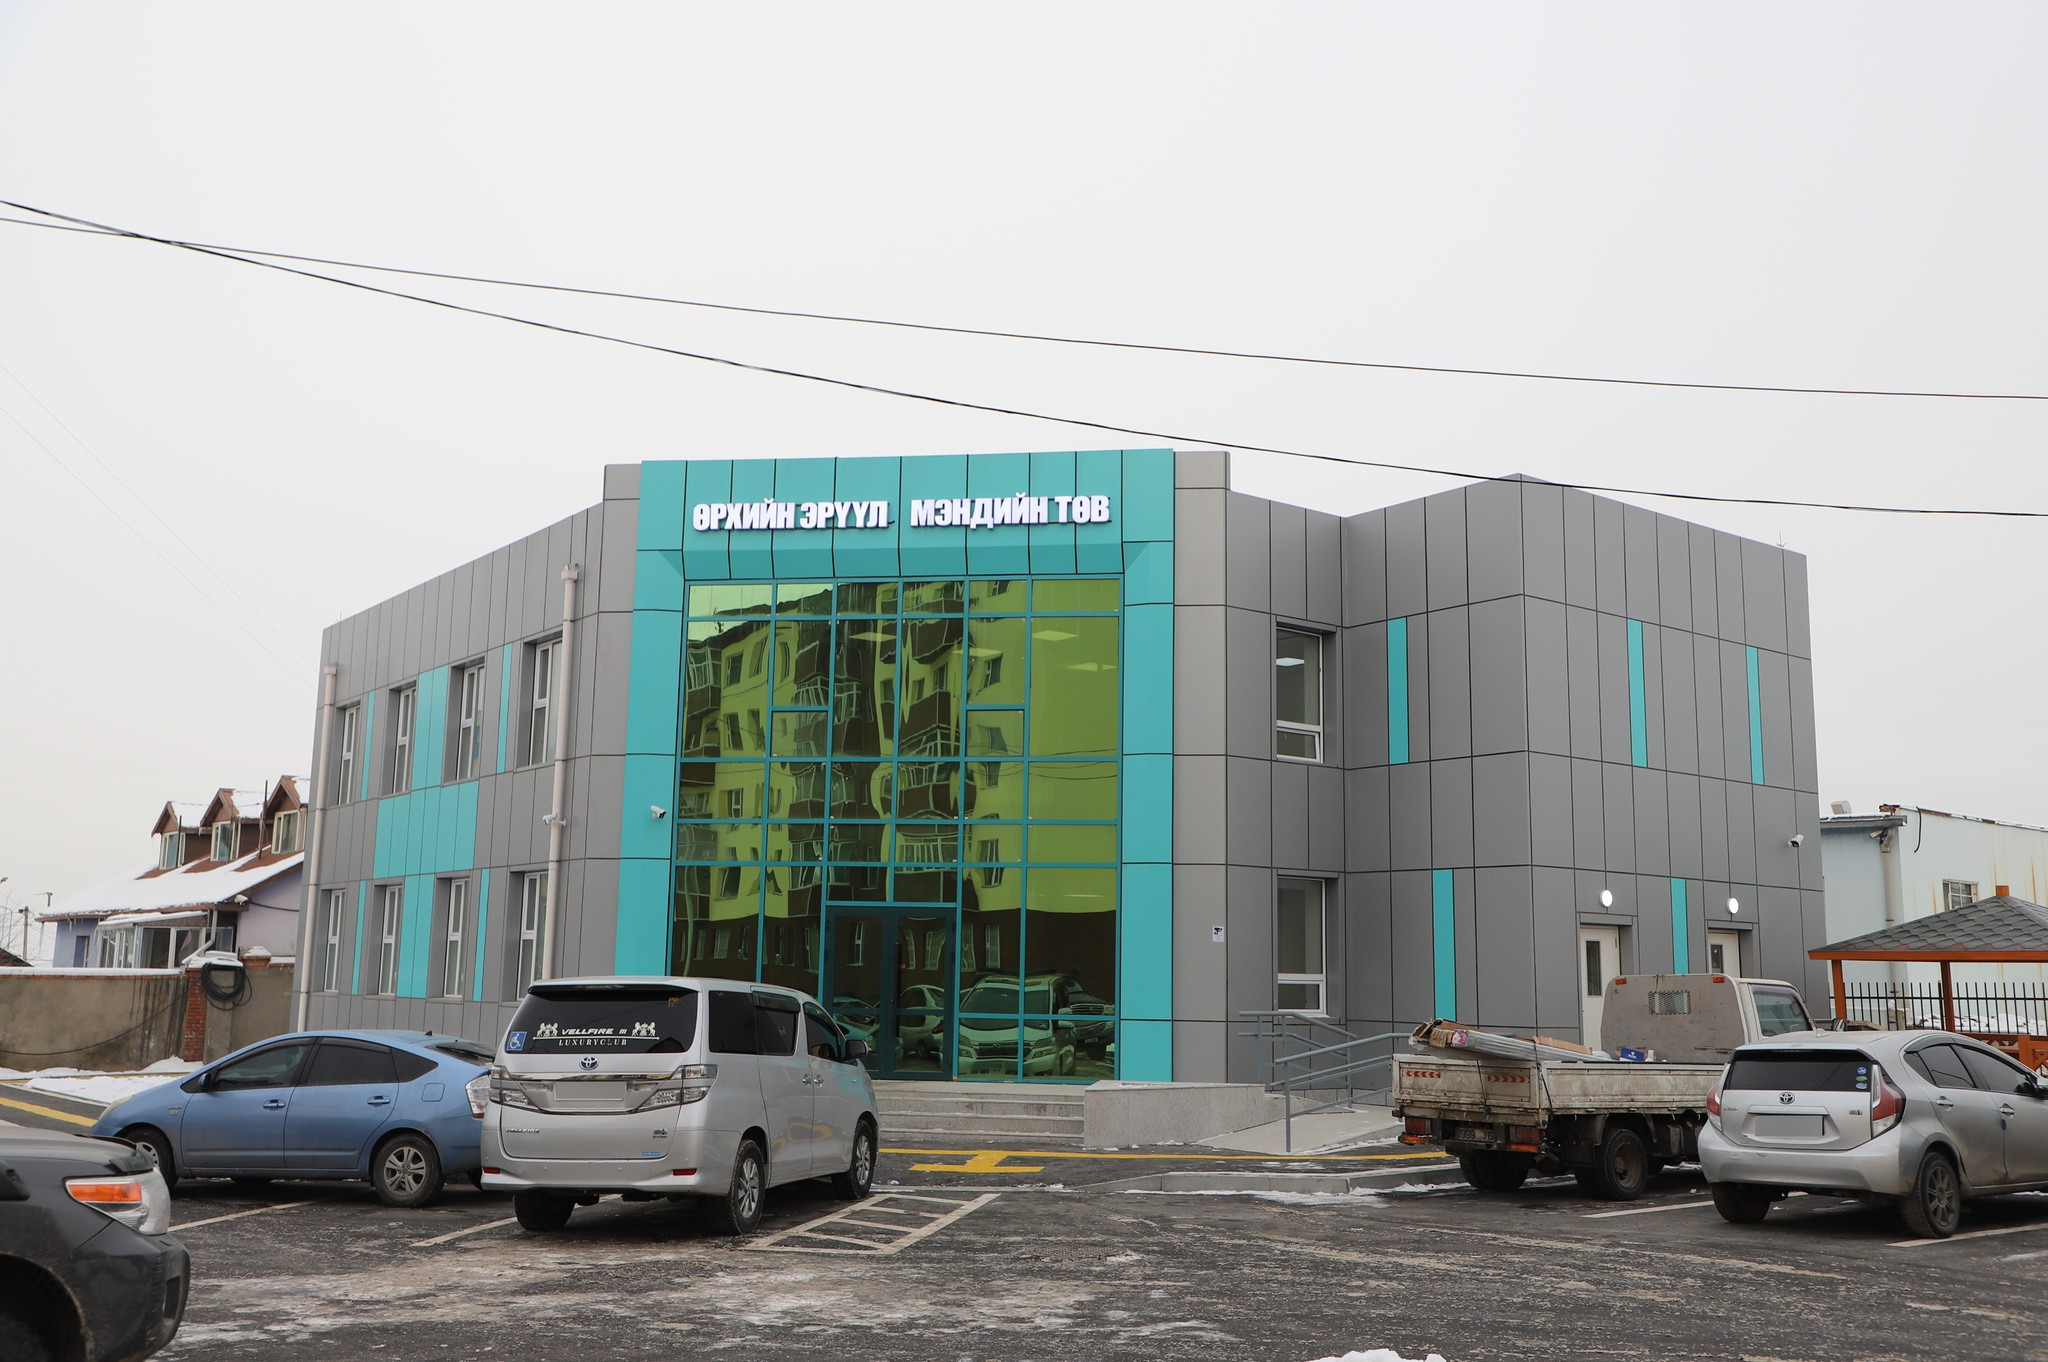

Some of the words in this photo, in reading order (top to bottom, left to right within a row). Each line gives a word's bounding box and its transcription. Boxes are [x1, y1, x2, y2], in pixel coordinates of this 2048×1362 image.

[693, 497, 796, 531] ӨРХИЙН
[800, 500, 889, 529] ЭРҮҮЛ
[910, 492, 1049, 530] МЭНДИЙН
[1055, 496, 1110, 524] ТӨВ
